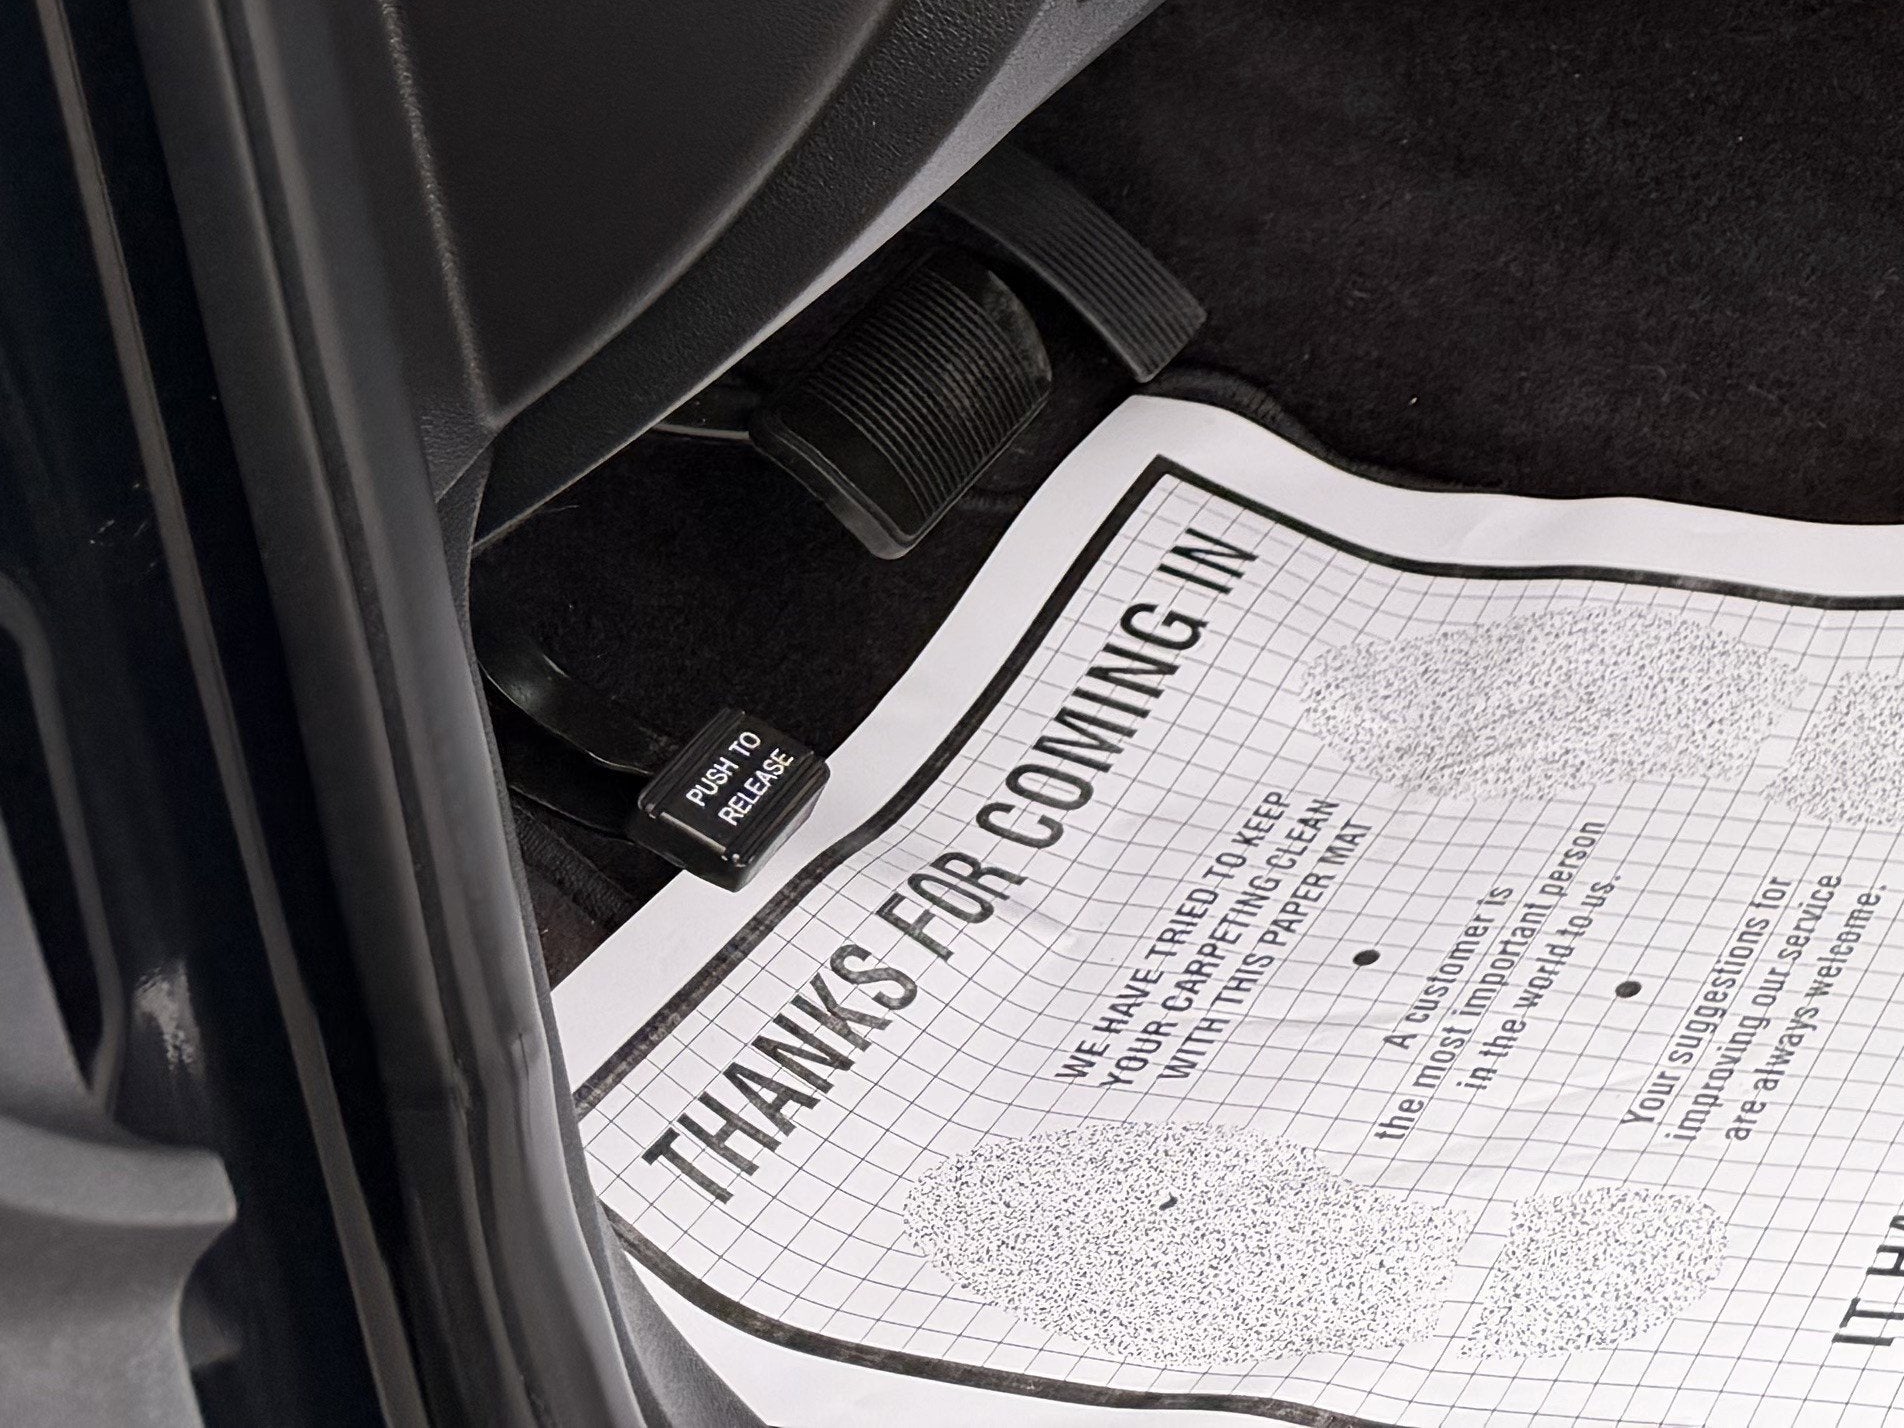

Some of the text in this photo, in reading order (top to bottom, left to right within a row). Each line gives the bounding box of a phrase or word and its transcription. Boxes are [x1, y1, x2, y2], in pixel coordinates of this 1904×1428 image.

[641, 527, 1260, 1205] THANKS FOR COMING IN
[686, 732, 761, 806] PUSH TO
[718, 748, 794, 826] RELEASE
[1055, 791, 1291, 1078] WE HAVE TRIED TO KEEP
[1100, 798, 1341, 1087] YOUR CARPETING CLEAN
[1157, 820, 1373, 1079] WITH THIS PAPER MAT
[1374, 820, 1606, 1140] the most important person
[1383, 886, 1513, 1050] A customer is
[1457, 875, 1622, 1090] in the world to us.
[1620, 876, 1792, 1125] Your suggestions for
[1665, 875, 1842, 1141] improving our service
[1725, 885, 1888, 1141] are always welcome.
